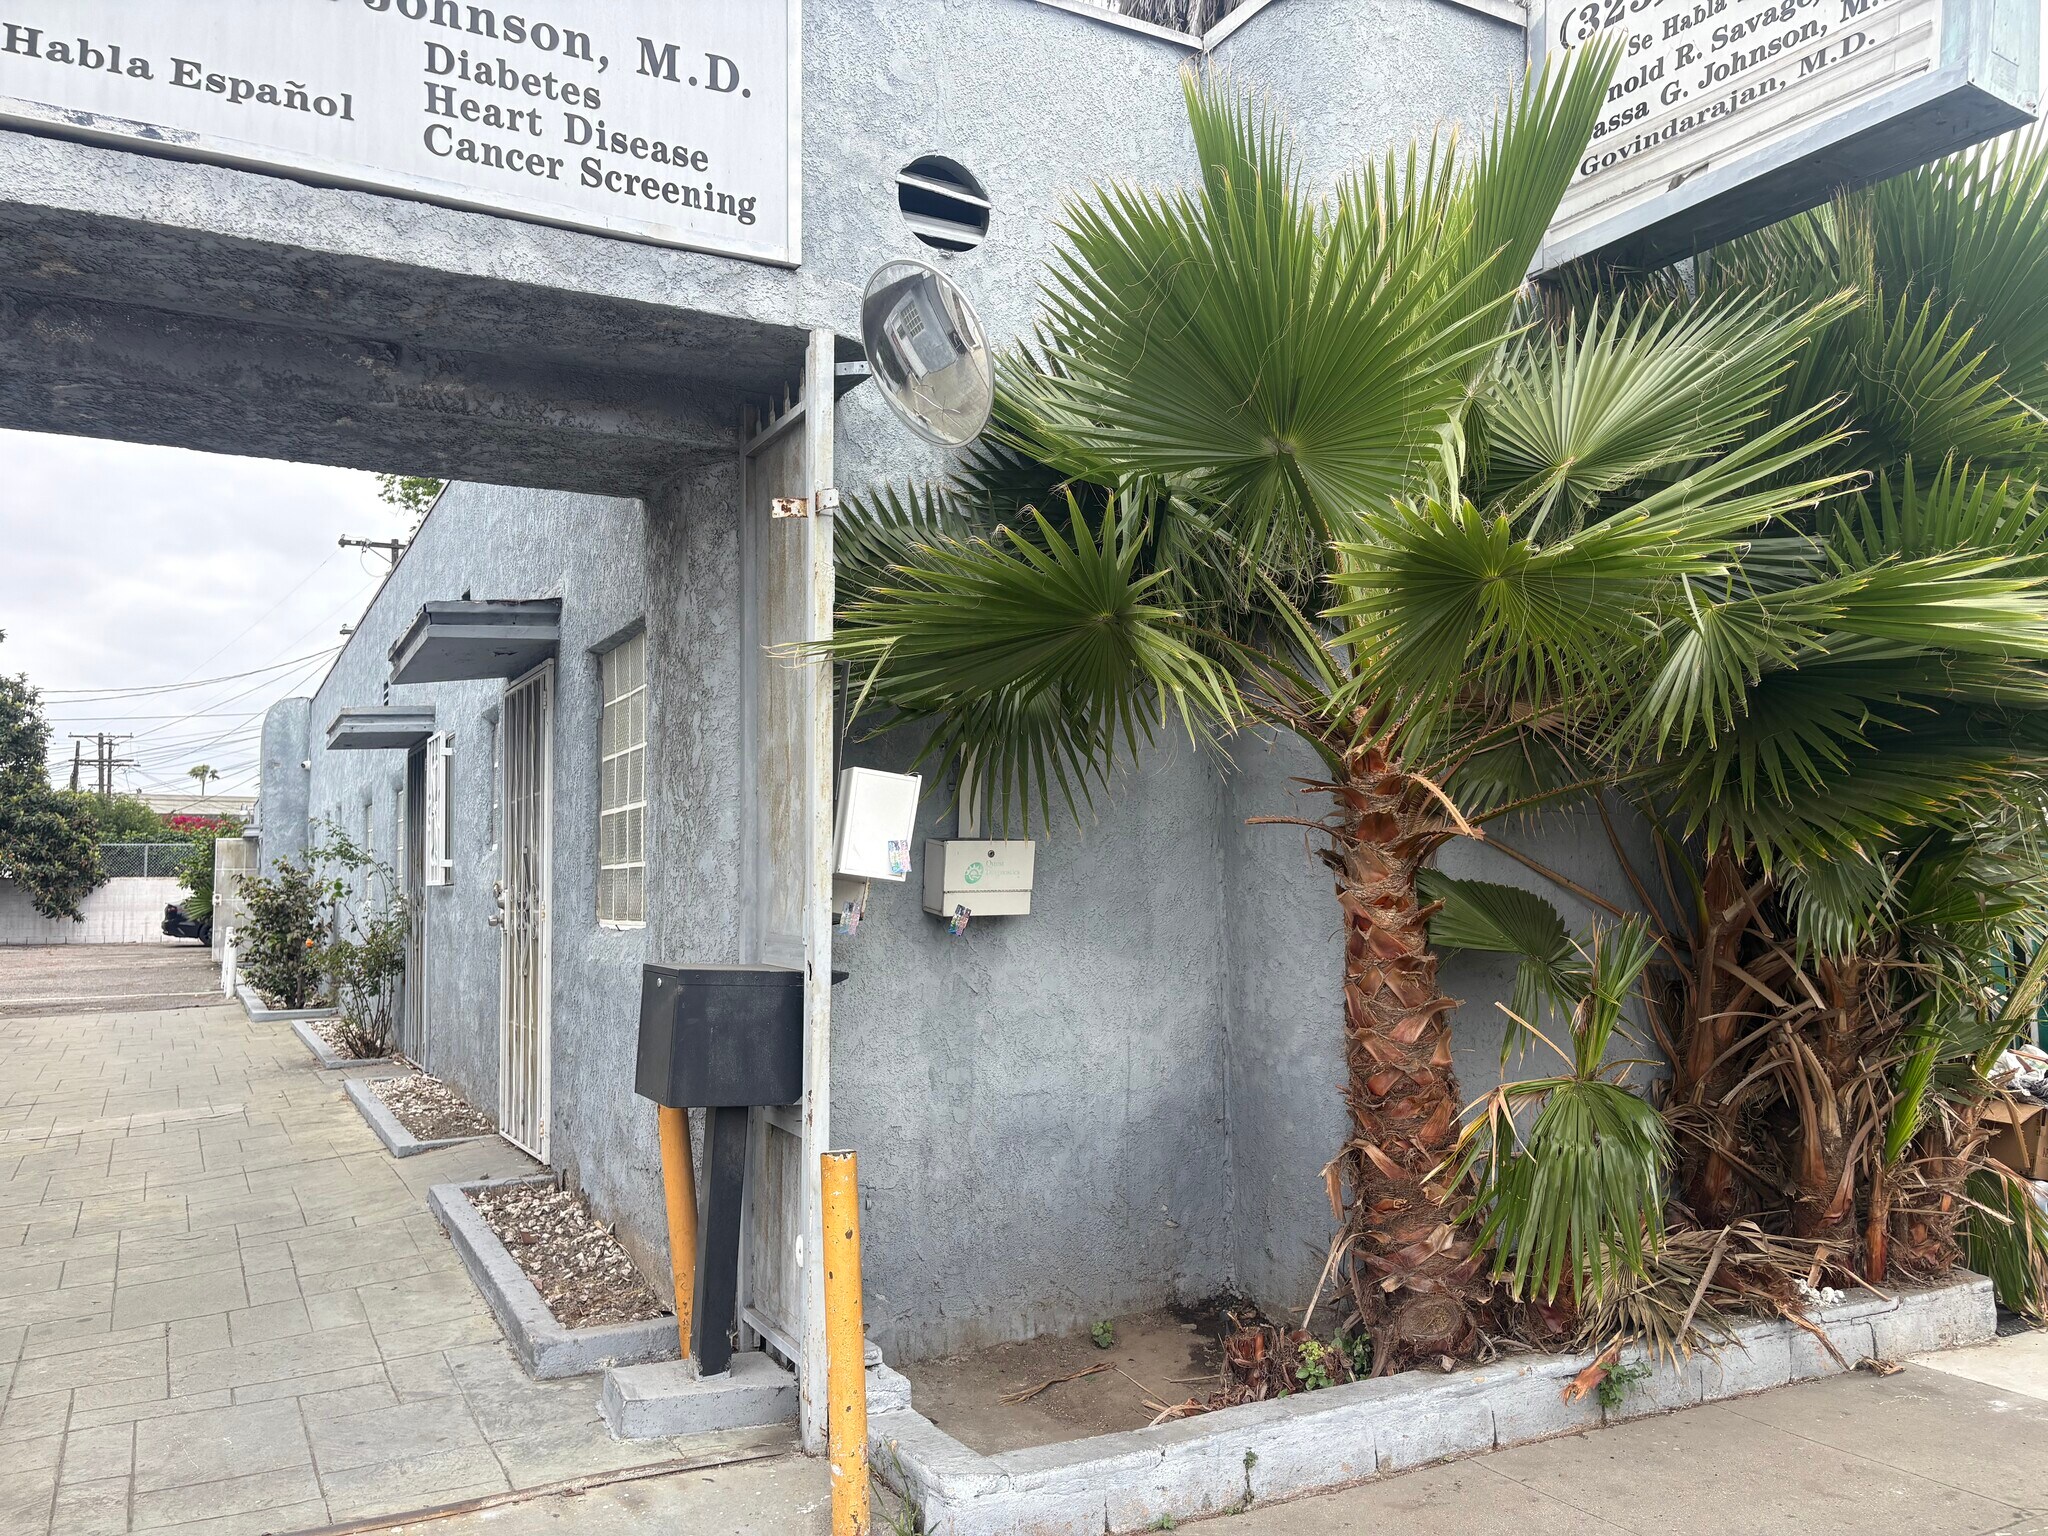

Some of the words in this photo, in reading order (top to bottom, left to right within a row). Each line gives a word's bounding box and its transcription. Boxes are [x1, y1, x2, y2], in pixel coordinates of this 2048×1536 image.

[1559, 0, 1664, 50] (32
[1628, 33, 1653, 57] Se
[1662, 0, 1727, 41] Habla
[1, 22, 154, 80] Habla
[169, 57, 355, 121] Español
[424, 41, 601, 109] Diabetes
[636, 36, 752, 99] M.D.
[1580, 76, 1786, 176] Govindarajan,
[1797, 32, 1875, 78] M.D.
[1592, 101, 1650, 139] assa
[1660, 80, 1688, 106] G.
[1697, 24, 1828, 90] Johnson,
[1839, 0, 1892, 23] M.
[1607, 56, 1664, 103] nold
[1674, 43, 1702, 71] R.
[424, 81, 543, 137] Heart
[563, 112, 709, 172] Disease
[424, 123, 564, 180] Cancer
[581, 156, 756, 226] Screening
